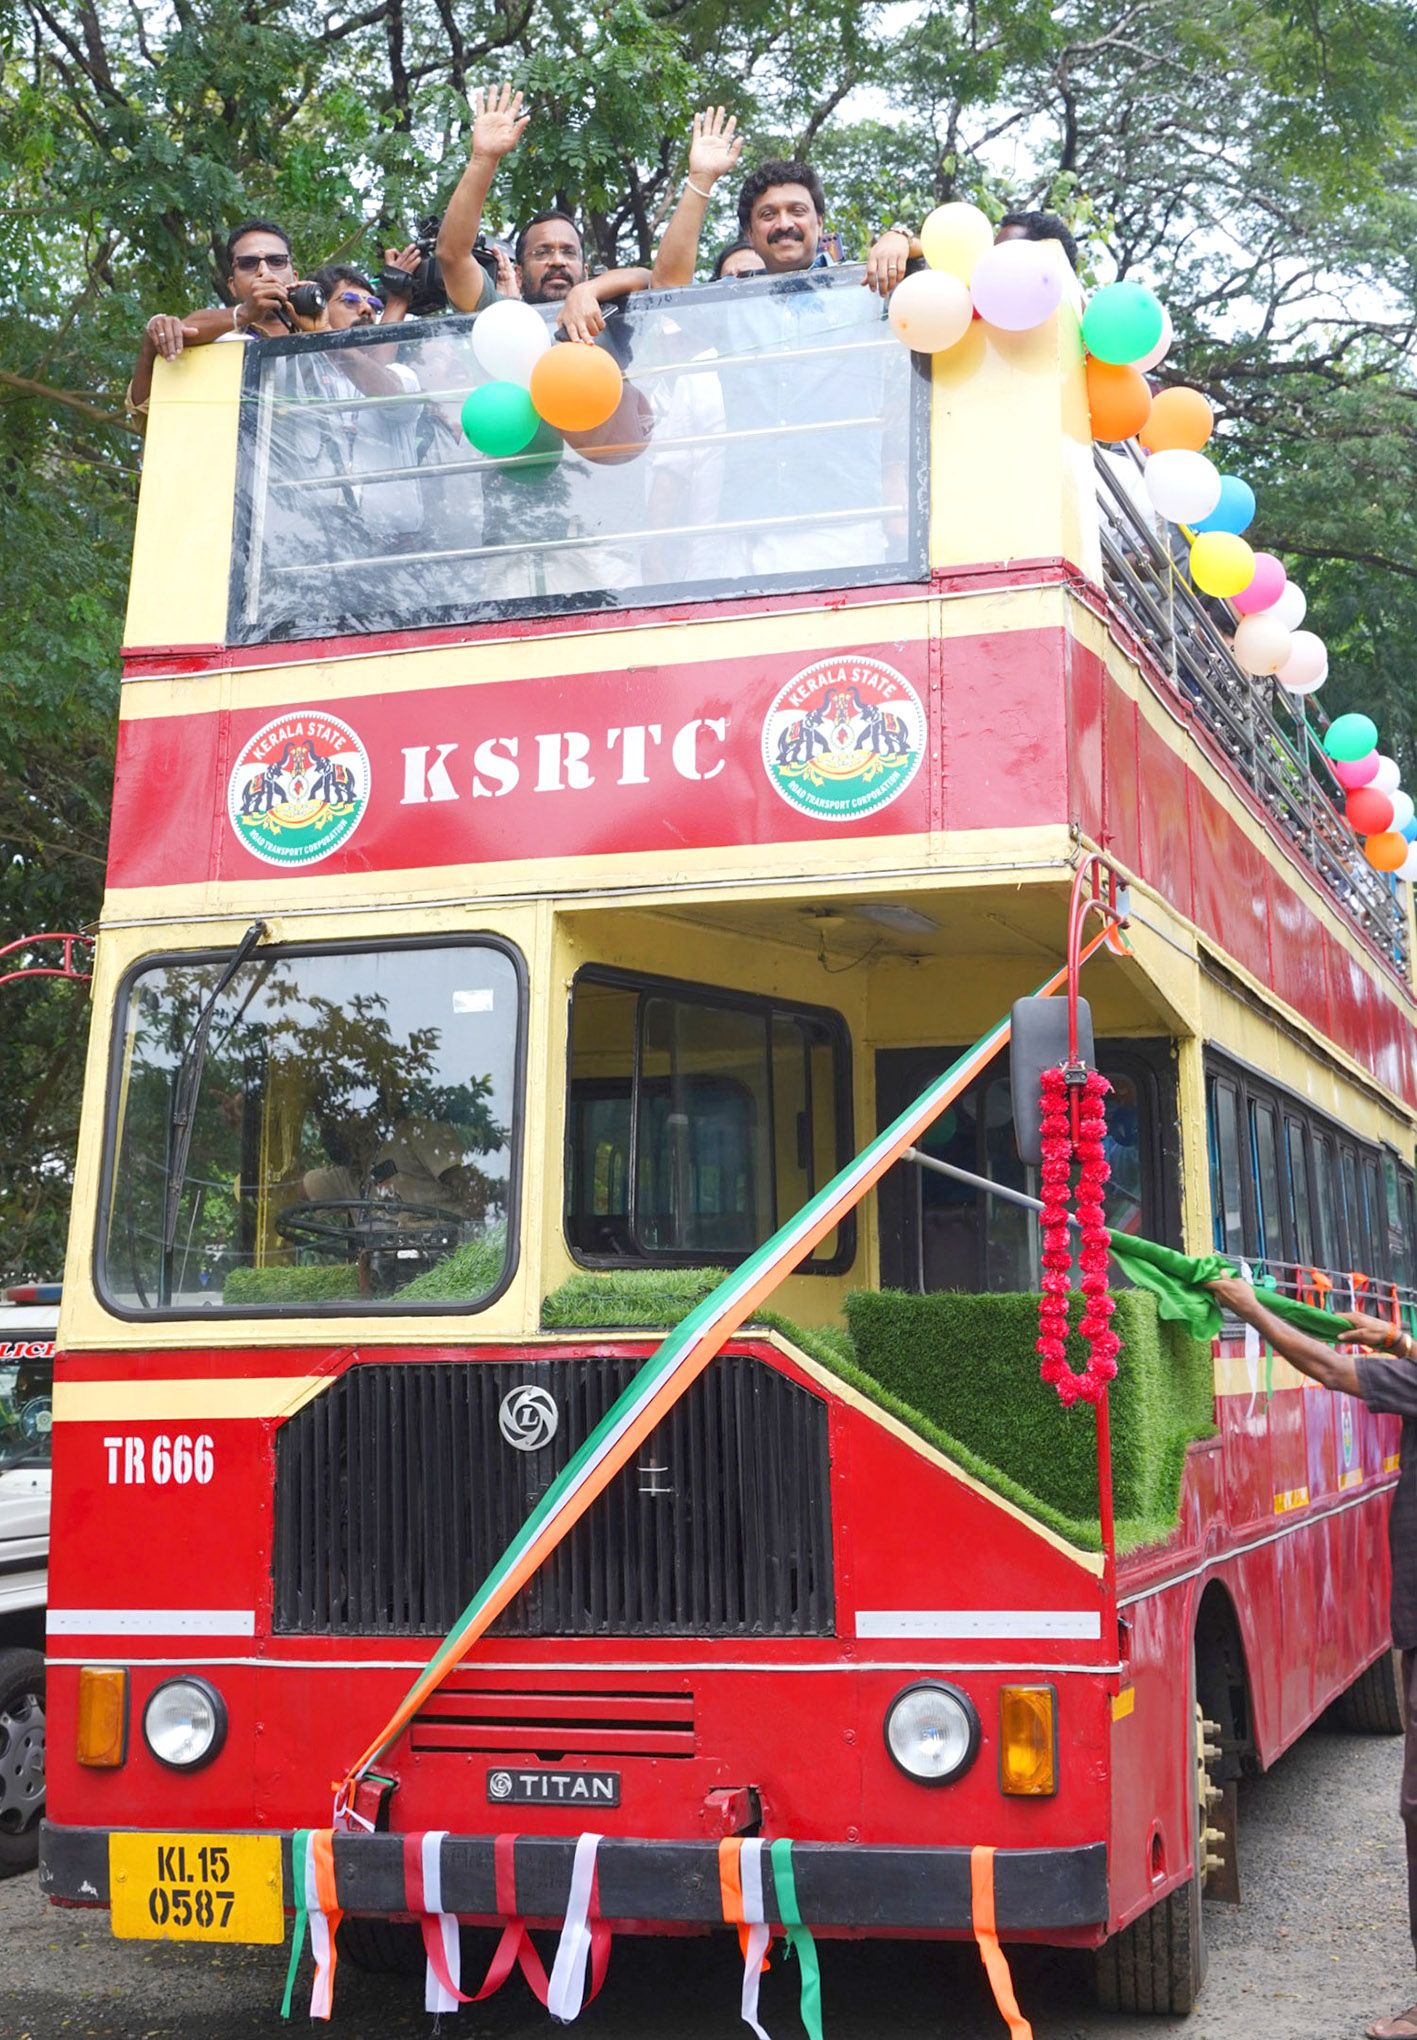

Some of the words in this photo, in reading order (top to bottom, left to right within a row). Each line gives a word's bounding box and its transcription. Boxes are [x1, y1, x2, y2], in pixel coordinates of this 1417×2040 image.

[788, 668, 847, 707] KERALA
[851, 667, 897, 698] STATE
[252, 722, 303, 760] KERALA
[307, 722, 346, 750] STATE
[400, 717, 728, 804] KSRTC
[787, 780, 806, 798] ROAD
[806, 793, 850, 809] TRANSPORT
[851, 770, 901, 808] CORPORATION
[264, 842, 303, 856] TRANSPORT
[304, 818, 348, 854] CORPORATION
[520, 1408, 539, 1426] L
[103, 1436, 145, 1484] TR
[152, 1434, 214, 1484] 666
[519, 1775, 613, 1798] TITAN
[149, 1887, 235, 1928] 0587
